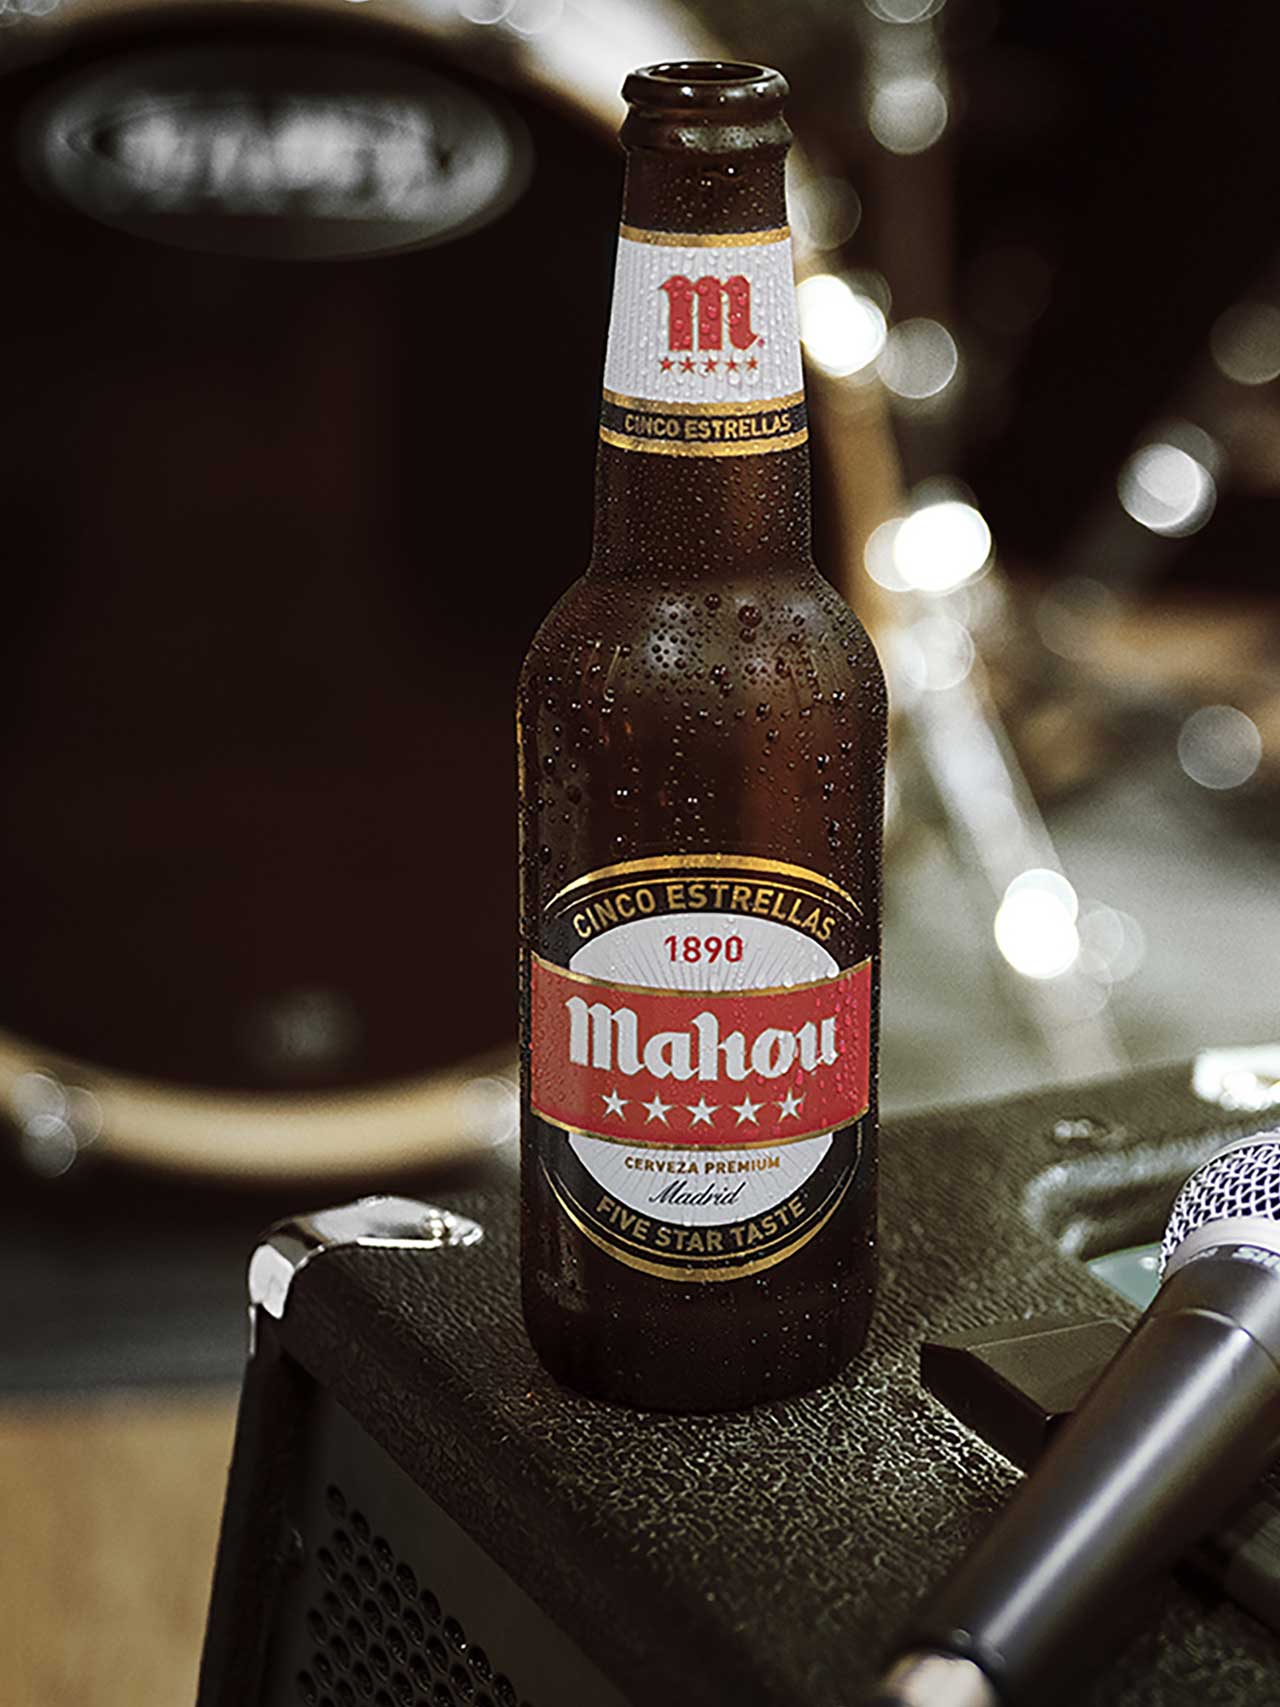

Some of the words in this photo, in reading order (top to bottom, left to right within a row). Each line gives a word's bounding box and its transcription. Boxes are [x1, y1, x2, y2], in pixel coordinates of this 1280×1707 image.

[624, 414, 680, 437] CINCO
[684, 414, 791, 439] ESTRELLAS
[573, 891, 656, 939] CINCO
[667, 884, 837, 941] ESTRELLAS
[664, 935, 744, 963] 1890
[565, 996, 839, 1081] Mahou
[624, 1156, 699, 1175] CERVEZA
[704, 1155, 780, 1174] PREMIUM
[647, 1180, 747, 1206] Madrid
[596, 1195, 650, 1241] FIVE
[655, 1227, 724, 1252] STAR
[731, 1196, 806, 1247] TASTE
